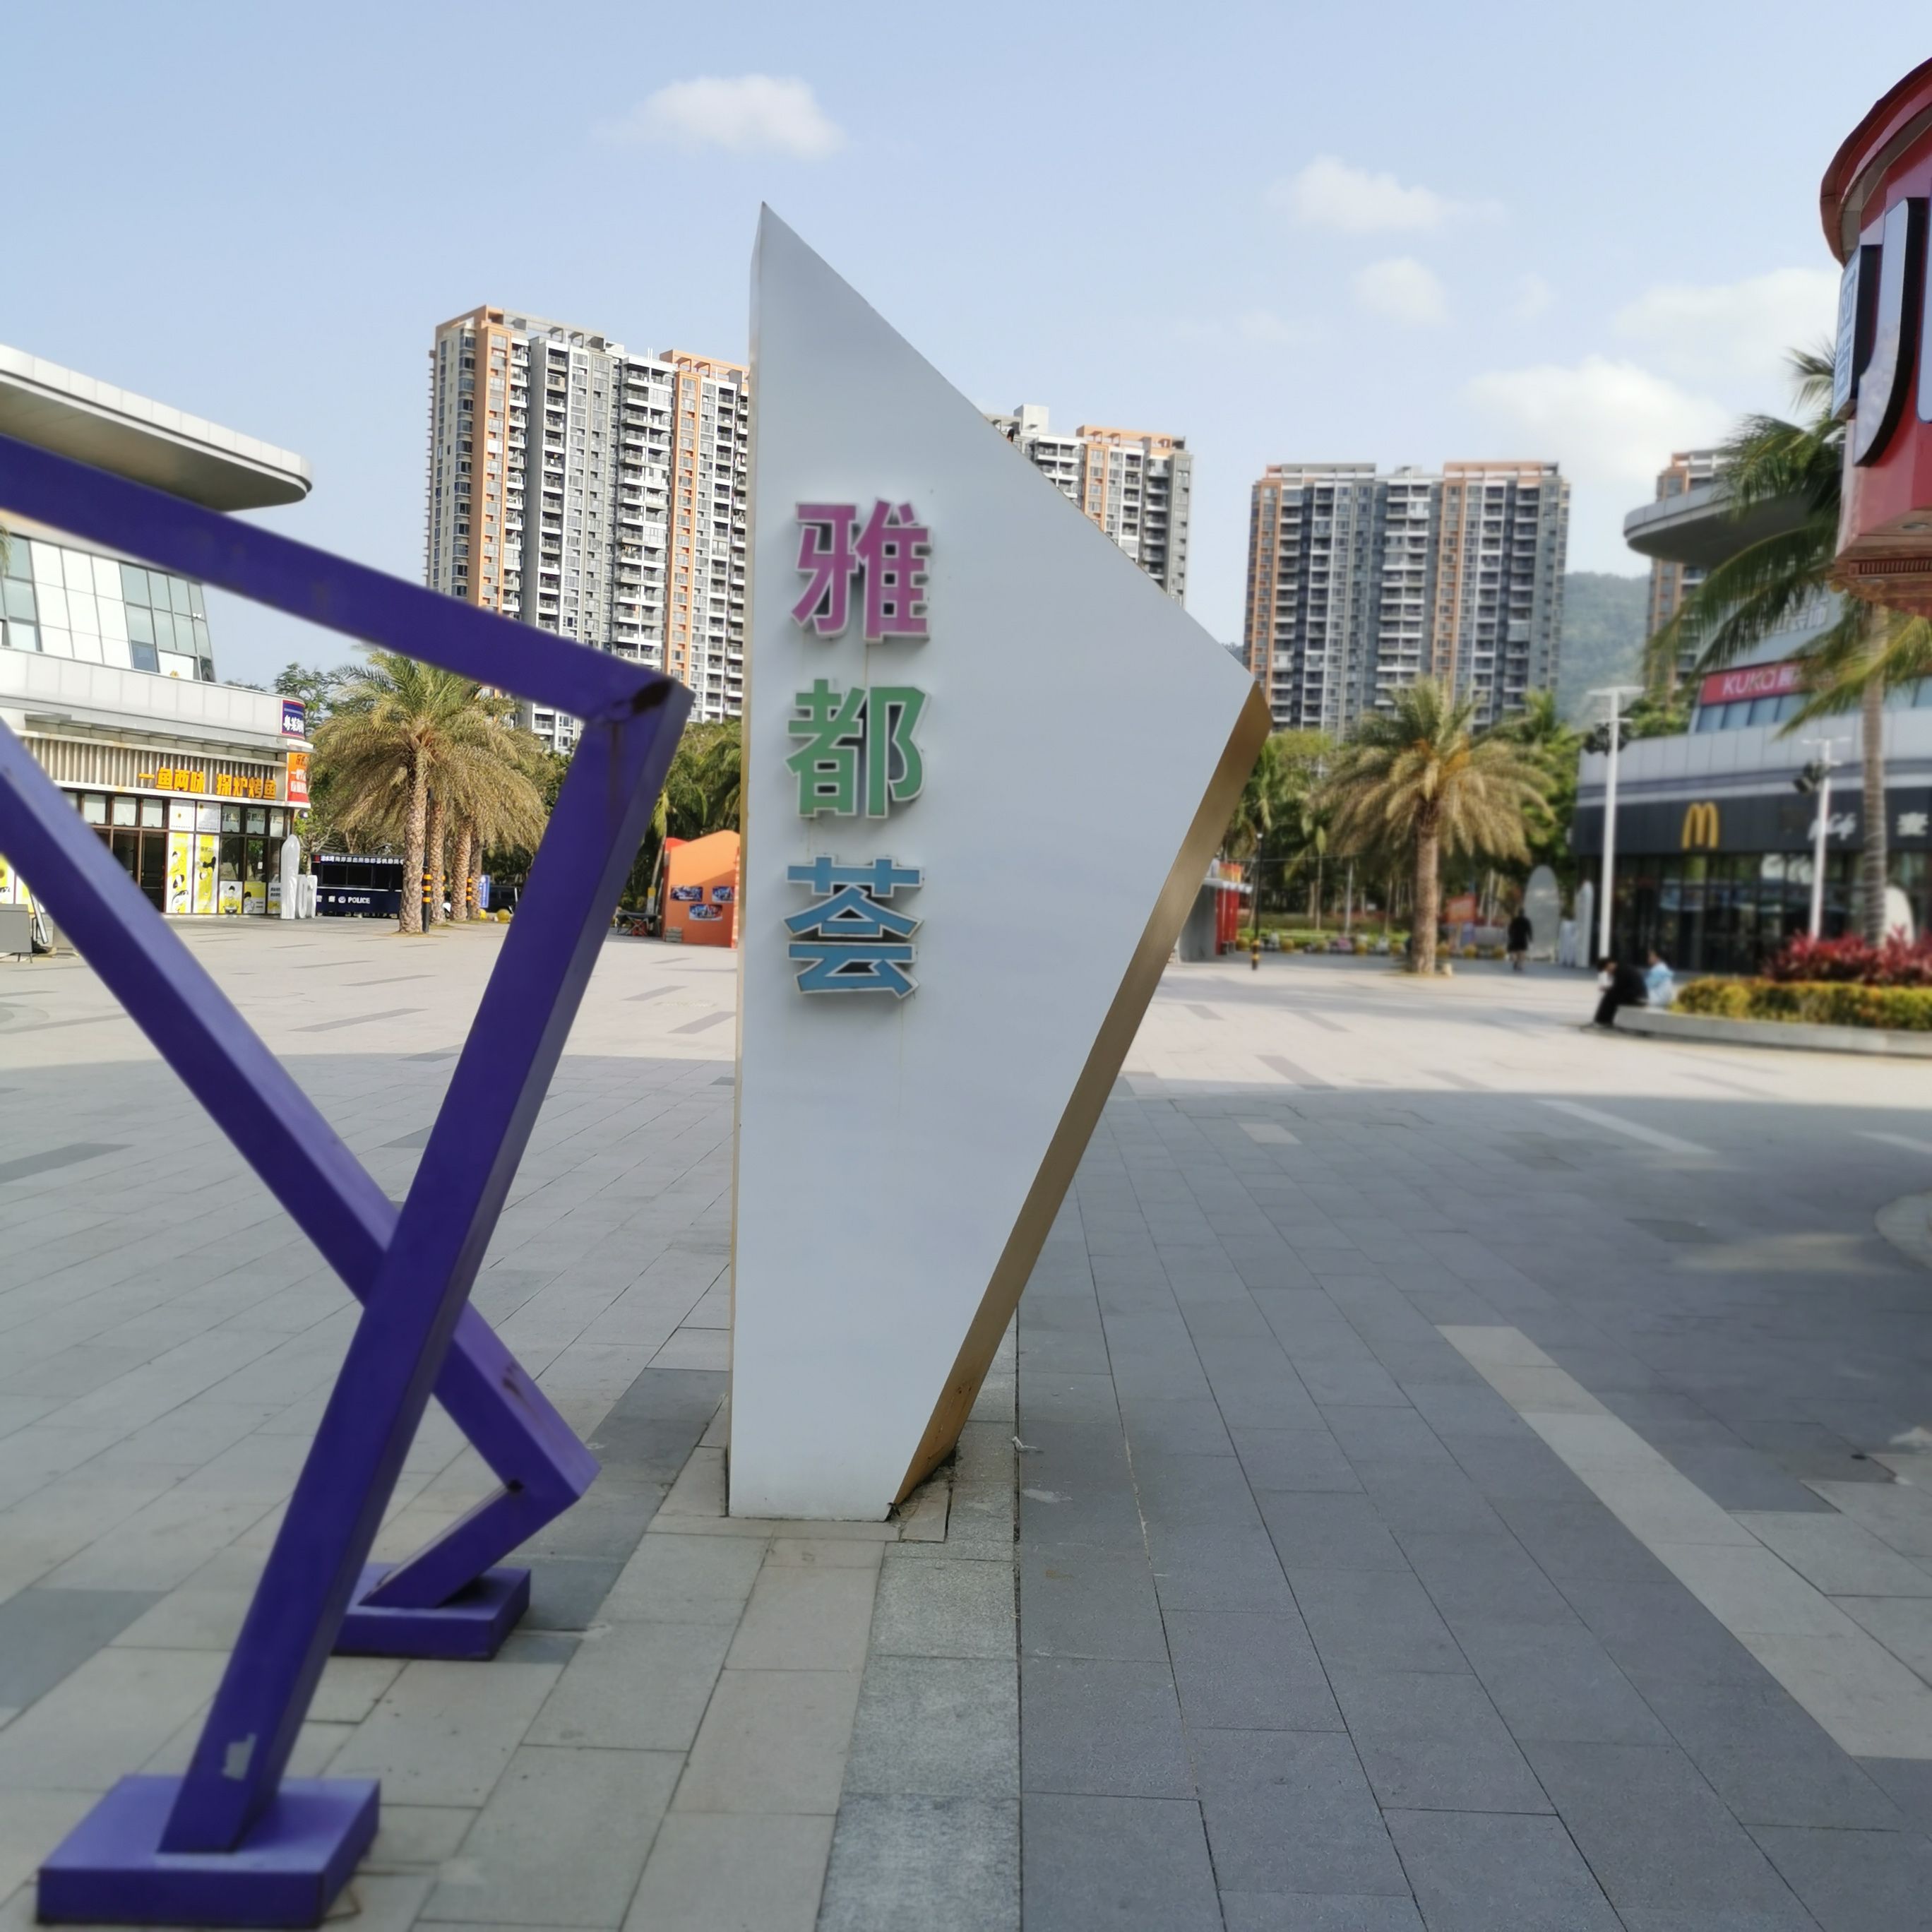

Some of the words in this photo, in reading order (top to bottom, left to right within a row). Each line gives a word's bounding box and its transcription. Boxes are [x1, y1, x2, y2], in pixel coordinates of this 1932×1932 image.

[138, 767, 205, 794] 一鱼两味
[785, 498, 931, 998] 雅都荟
